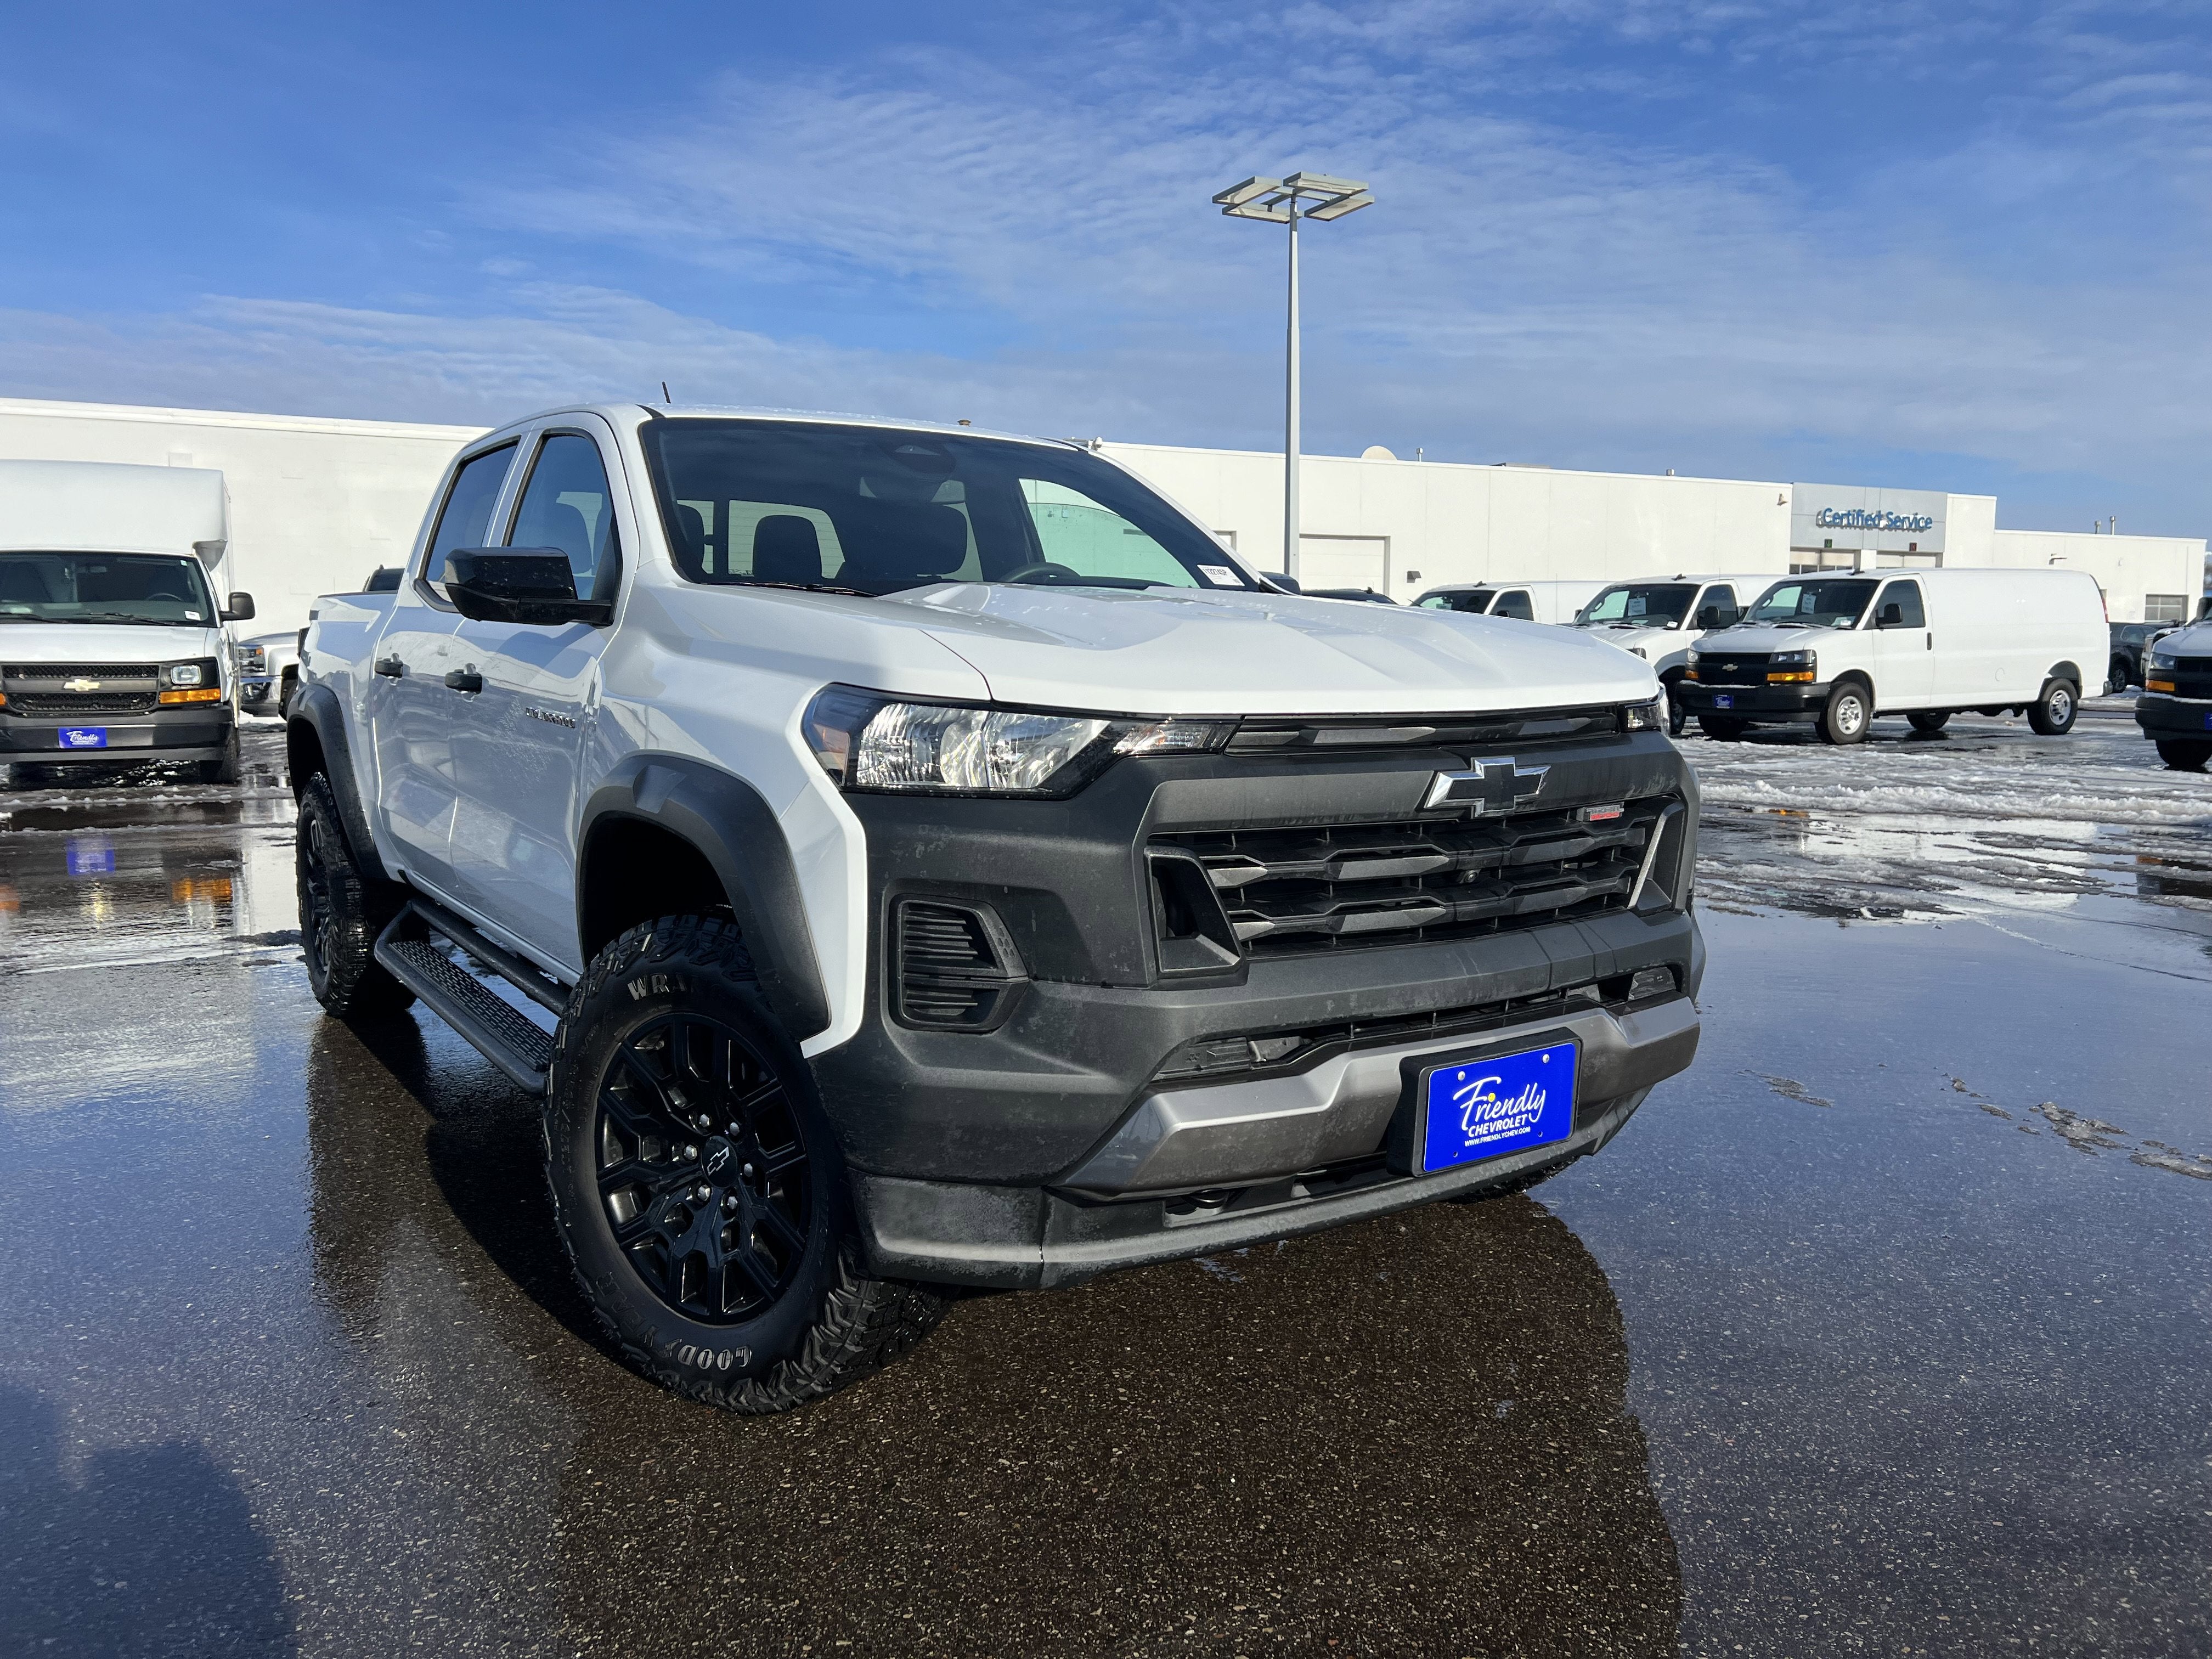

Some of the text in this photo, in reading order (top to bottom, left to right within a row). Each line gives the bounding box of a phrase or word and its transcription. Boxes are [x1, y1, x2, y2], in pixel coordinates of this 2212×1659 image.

[1822, 507, 1933, 529] Certified Service
[66, 731, 98, 743] Friendly
[1453, 1076, 1546, 1131] Friendly
[1464, 1126, 1531, 1147] WWW.FRIENDLYCHEV.COM
[1468, 1114, 1528, 1137] CHEVROLET
